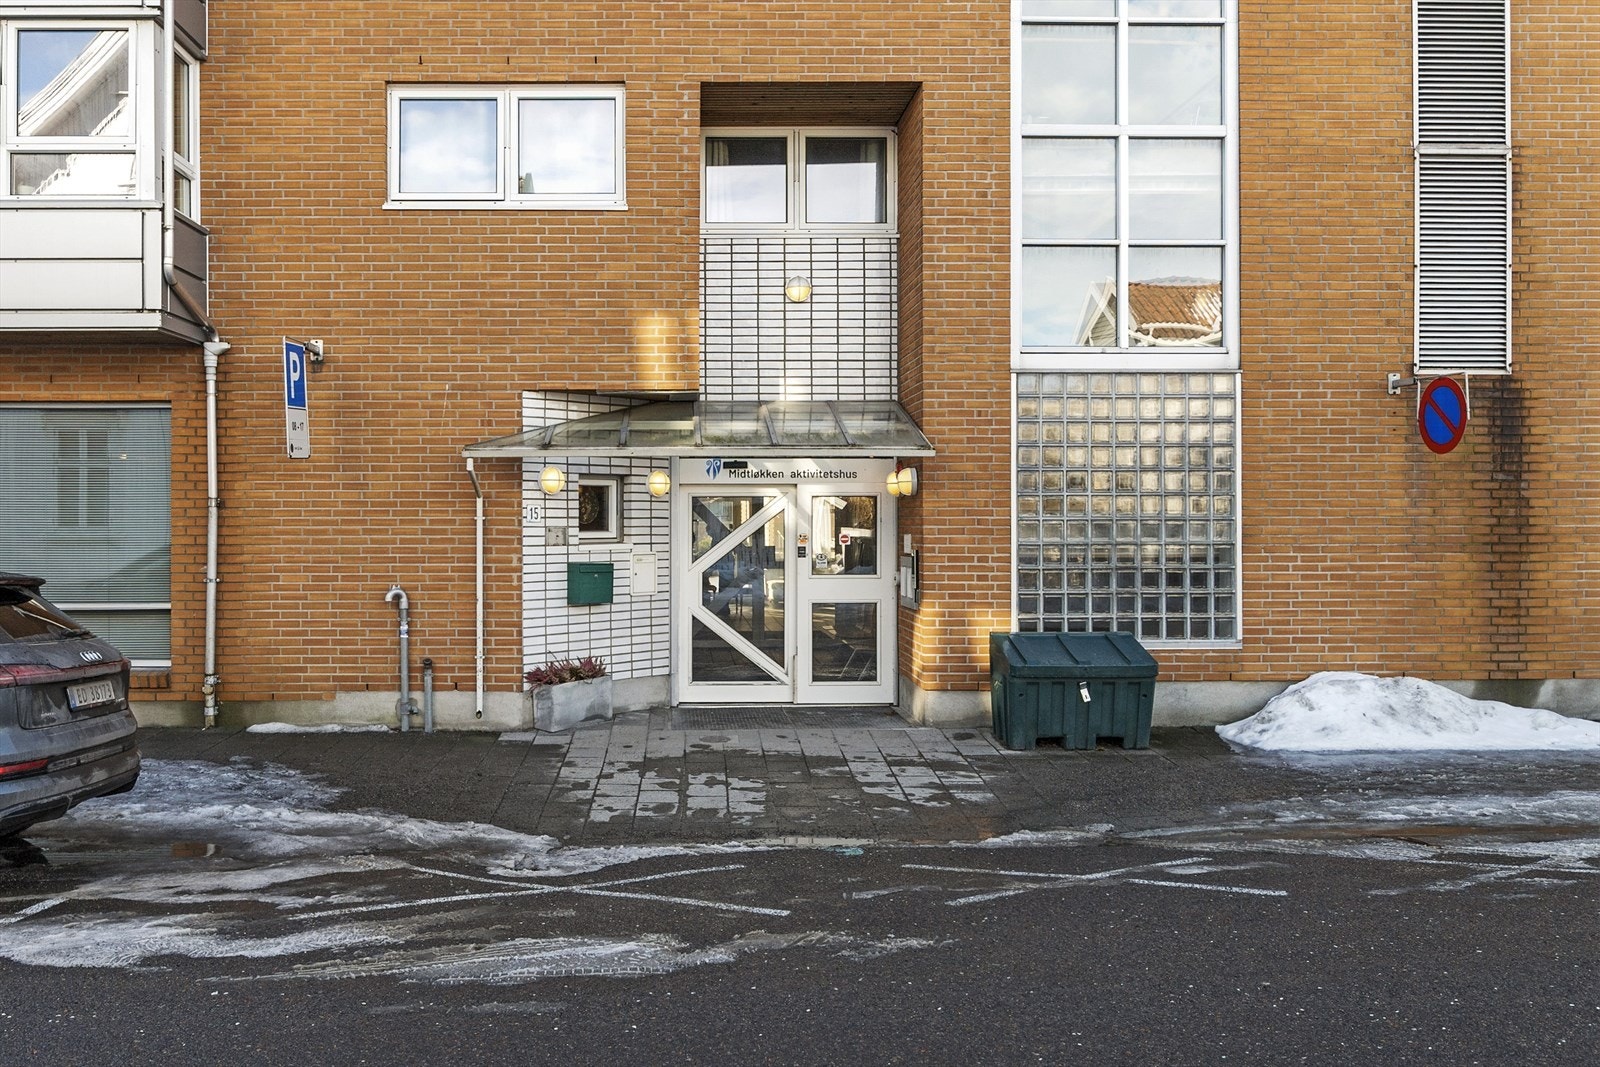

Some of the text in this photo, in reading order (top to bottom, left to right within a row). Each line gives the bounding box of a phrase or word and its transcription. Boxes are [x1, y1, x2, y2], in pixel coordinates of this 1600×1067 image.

[289, 351, 301, 399] P
[728, 469, 858, 479] Midtløkken aktivitetshus
[529, 507, 539, 520] 15
